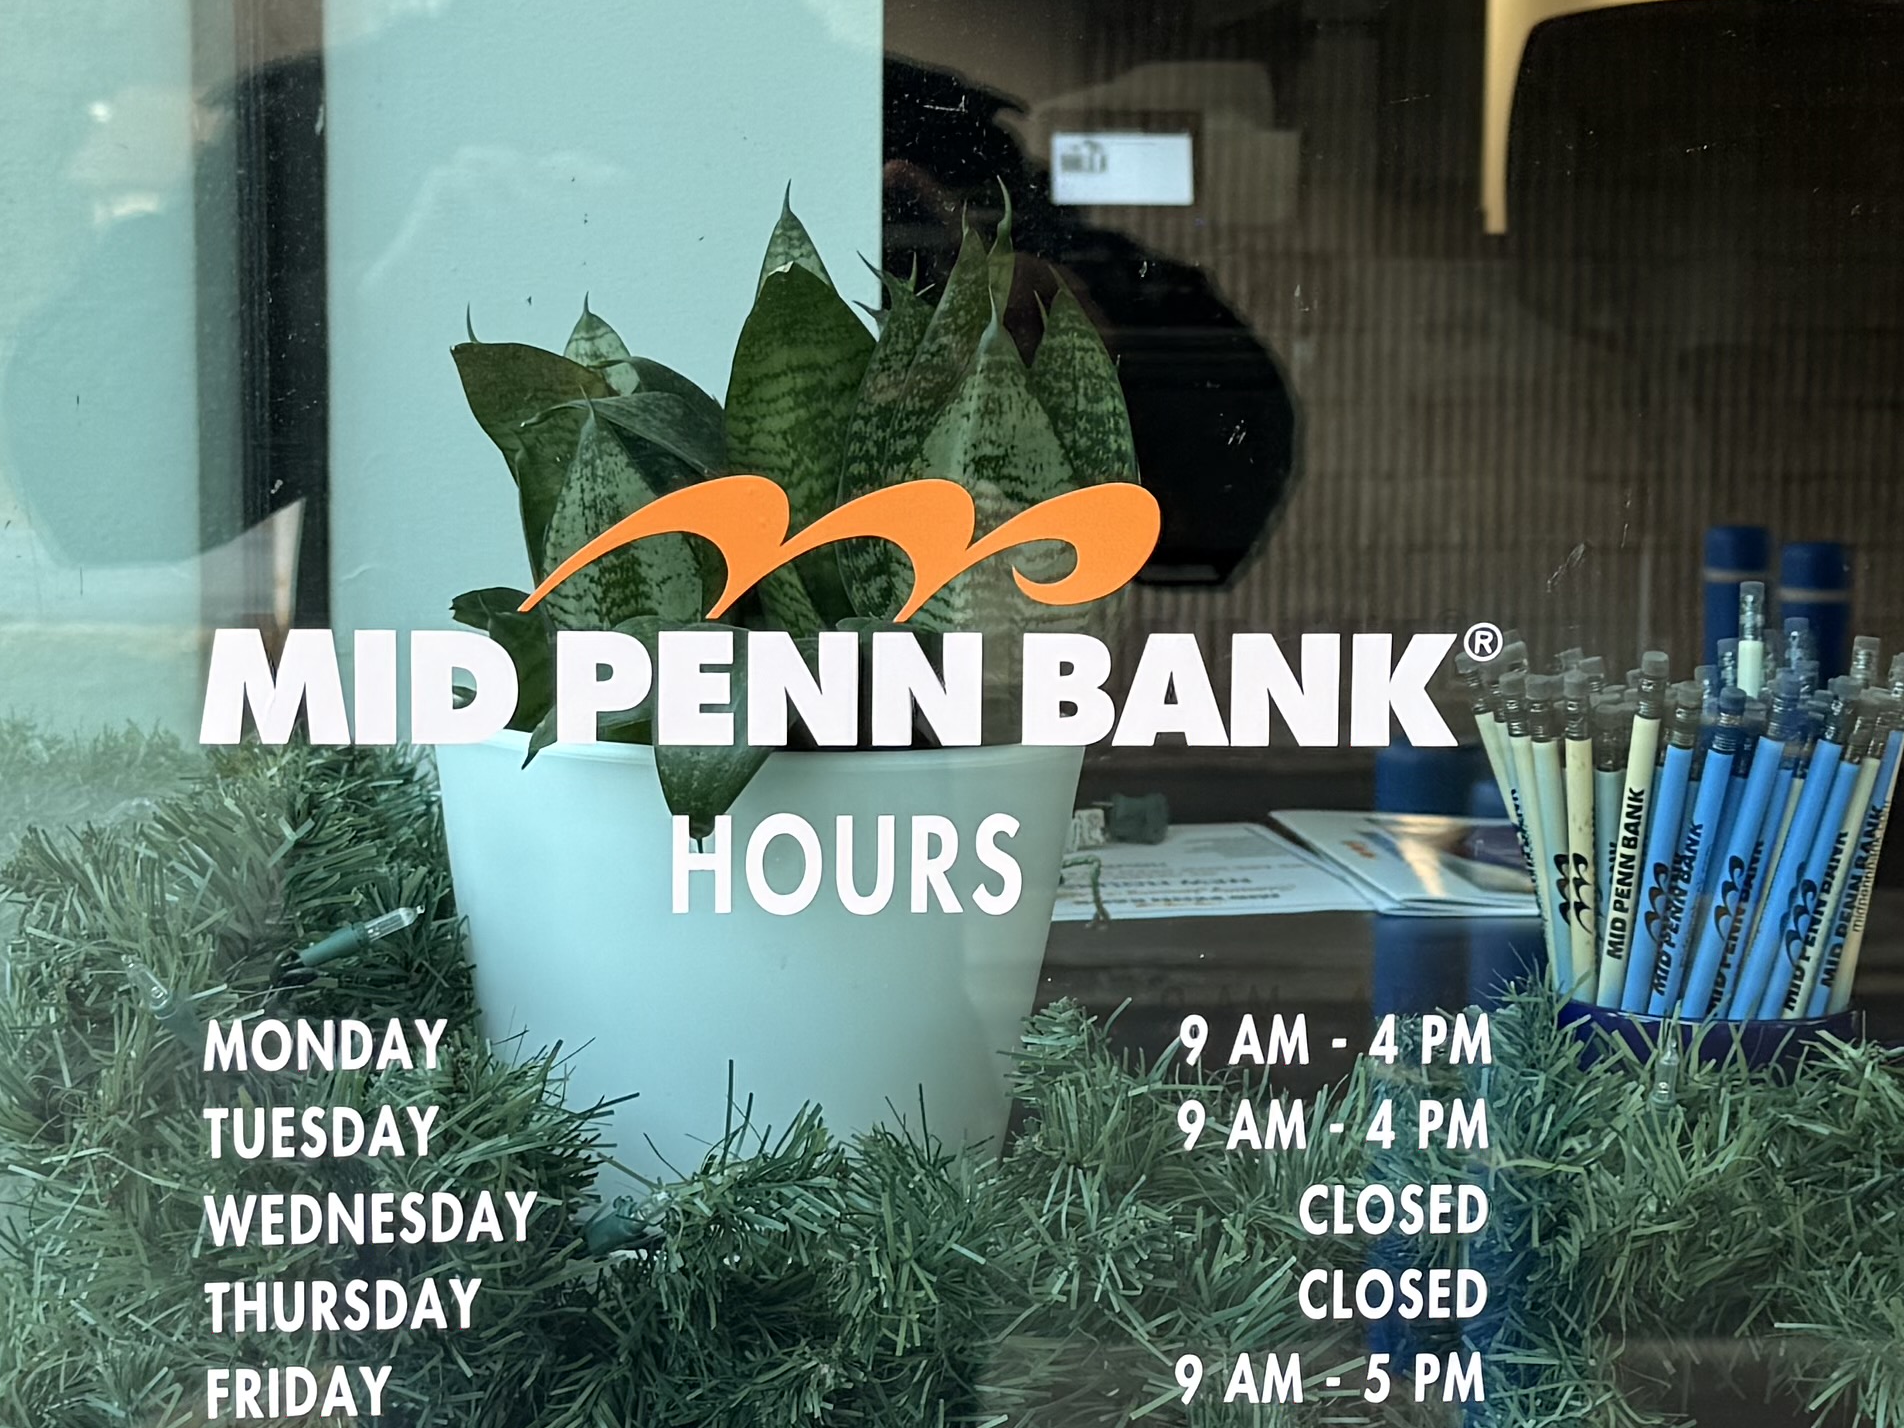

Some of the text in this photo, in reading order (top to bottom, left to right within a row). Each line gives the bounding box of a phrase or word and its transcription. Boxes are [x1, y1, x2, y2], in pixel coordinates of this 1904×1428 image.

[197, 627, 520, 747] MID
[555, 629, 984, 748] PENN
[1621, 787, 1645, 850] BANK
[670, 811, 1024, 917] HOURS
[1613, 854, 1636, 913] PENN
[1606, 918, 1627, 960] MID
[1821, 943, 1844, 988] MID
[202, 1016, 449, 1073] MONDAY
[1178, 1013, 1209, 1067] 9
[1227, 1012, 1310, 1066] AM
[1367, 1012, 1399, 1066] 4
[1420, 1012, 1493, 1066] PM
[202, 1103, 441, 1160] TUESDAY
[1176, 1098, 1207, 1152] 9
[1225, 1097, 1308, 1152] AM
[1364, 1097, 1396, 1150] 4
[1417, 1097, 1490, 1150] PM
[202, 1183, 1489, 1248] WEDNESDAY CLOSED
[203, 1267, 1489, 1334] THURSDAY CLOSED
[206, 1364, 393, 1421] FRIDAY
[1173, 1353, 1204, 1406] 9
[1222, 1351, 1305, 1405] AM
[1362, 1352, 1392, 1404] 5
[1413, 1350, 1486, 1404] PM
